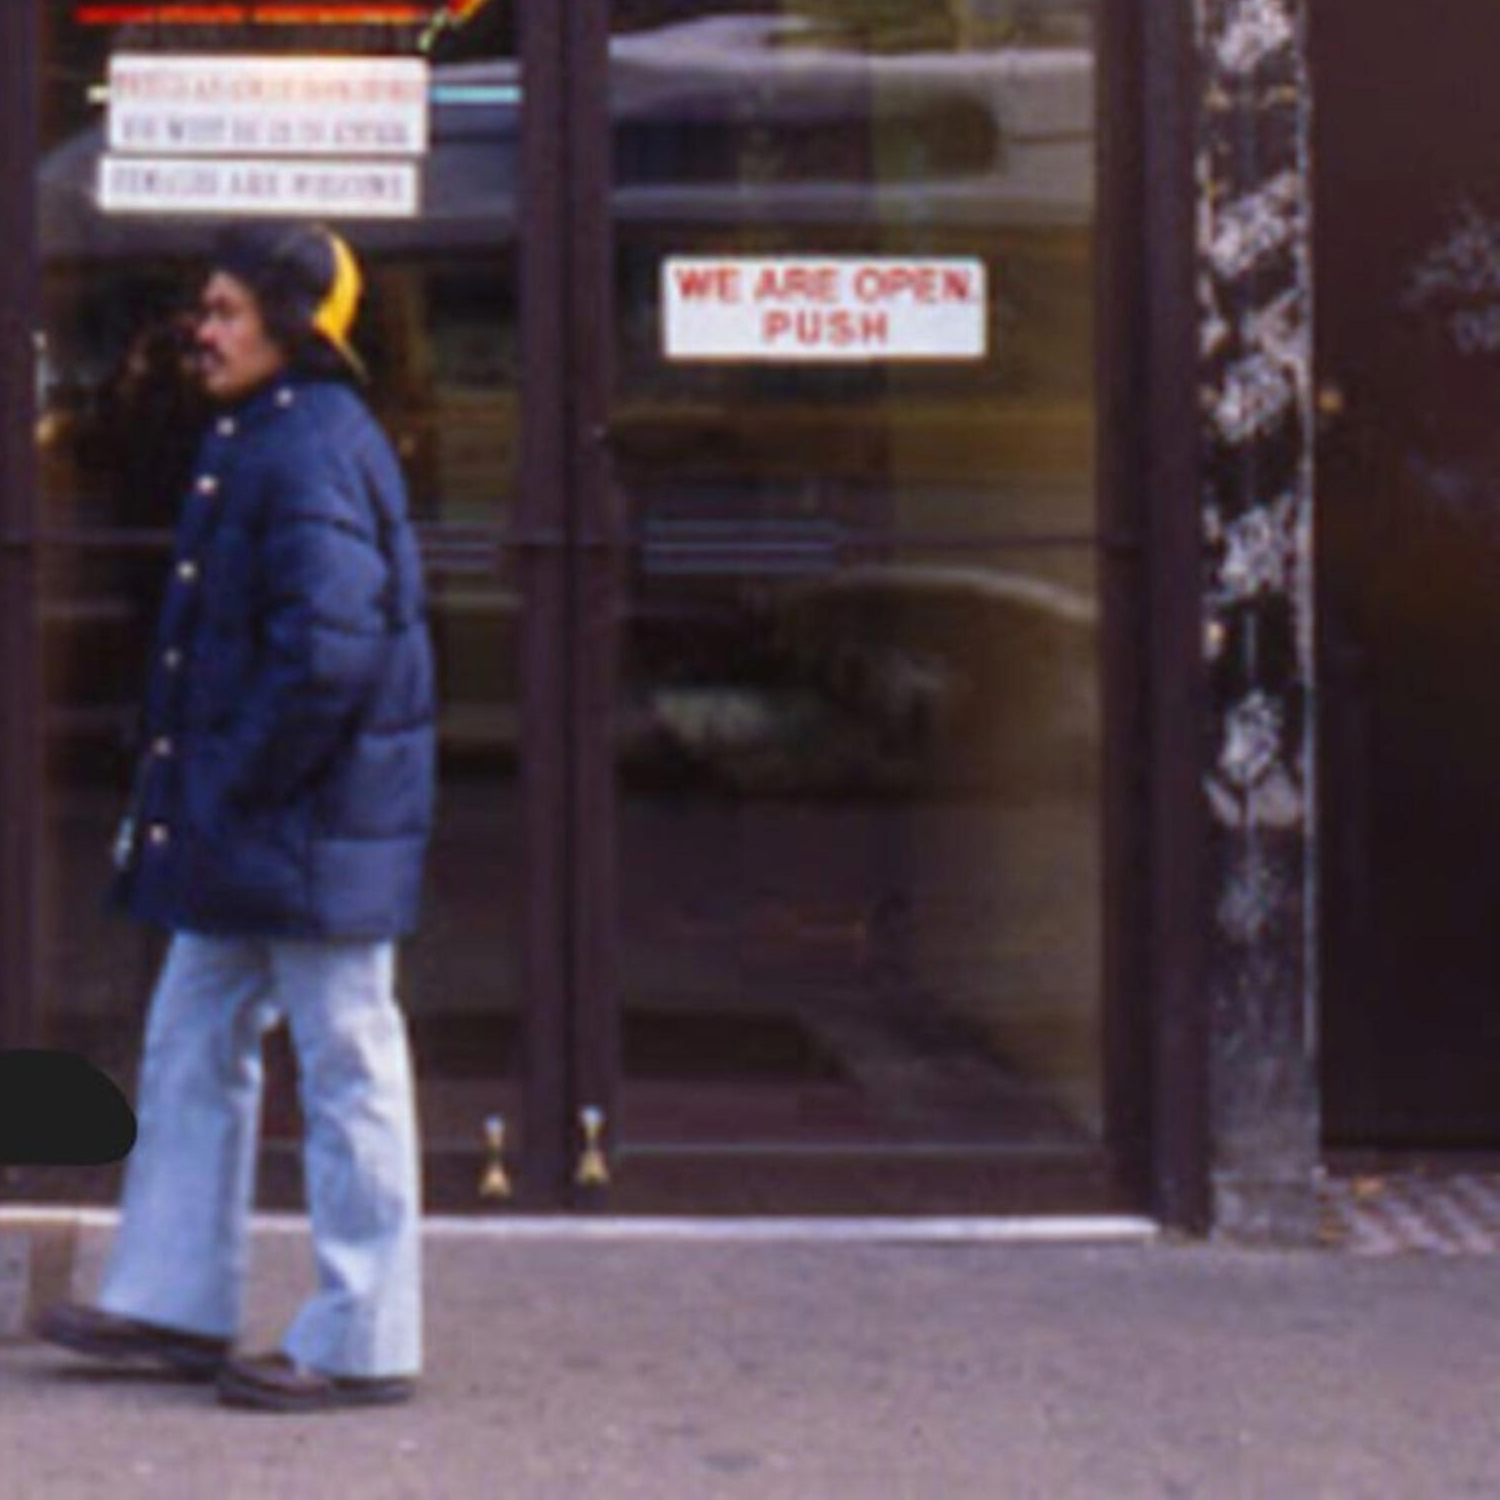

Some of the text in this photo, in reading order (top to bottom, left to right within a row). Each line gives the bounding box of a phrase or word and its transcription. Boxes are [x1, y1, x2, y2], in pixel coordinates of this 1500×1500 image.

[675, 265, 971, 302] WE ARE OPEN
[763, 310, 889, 345] PUSH
